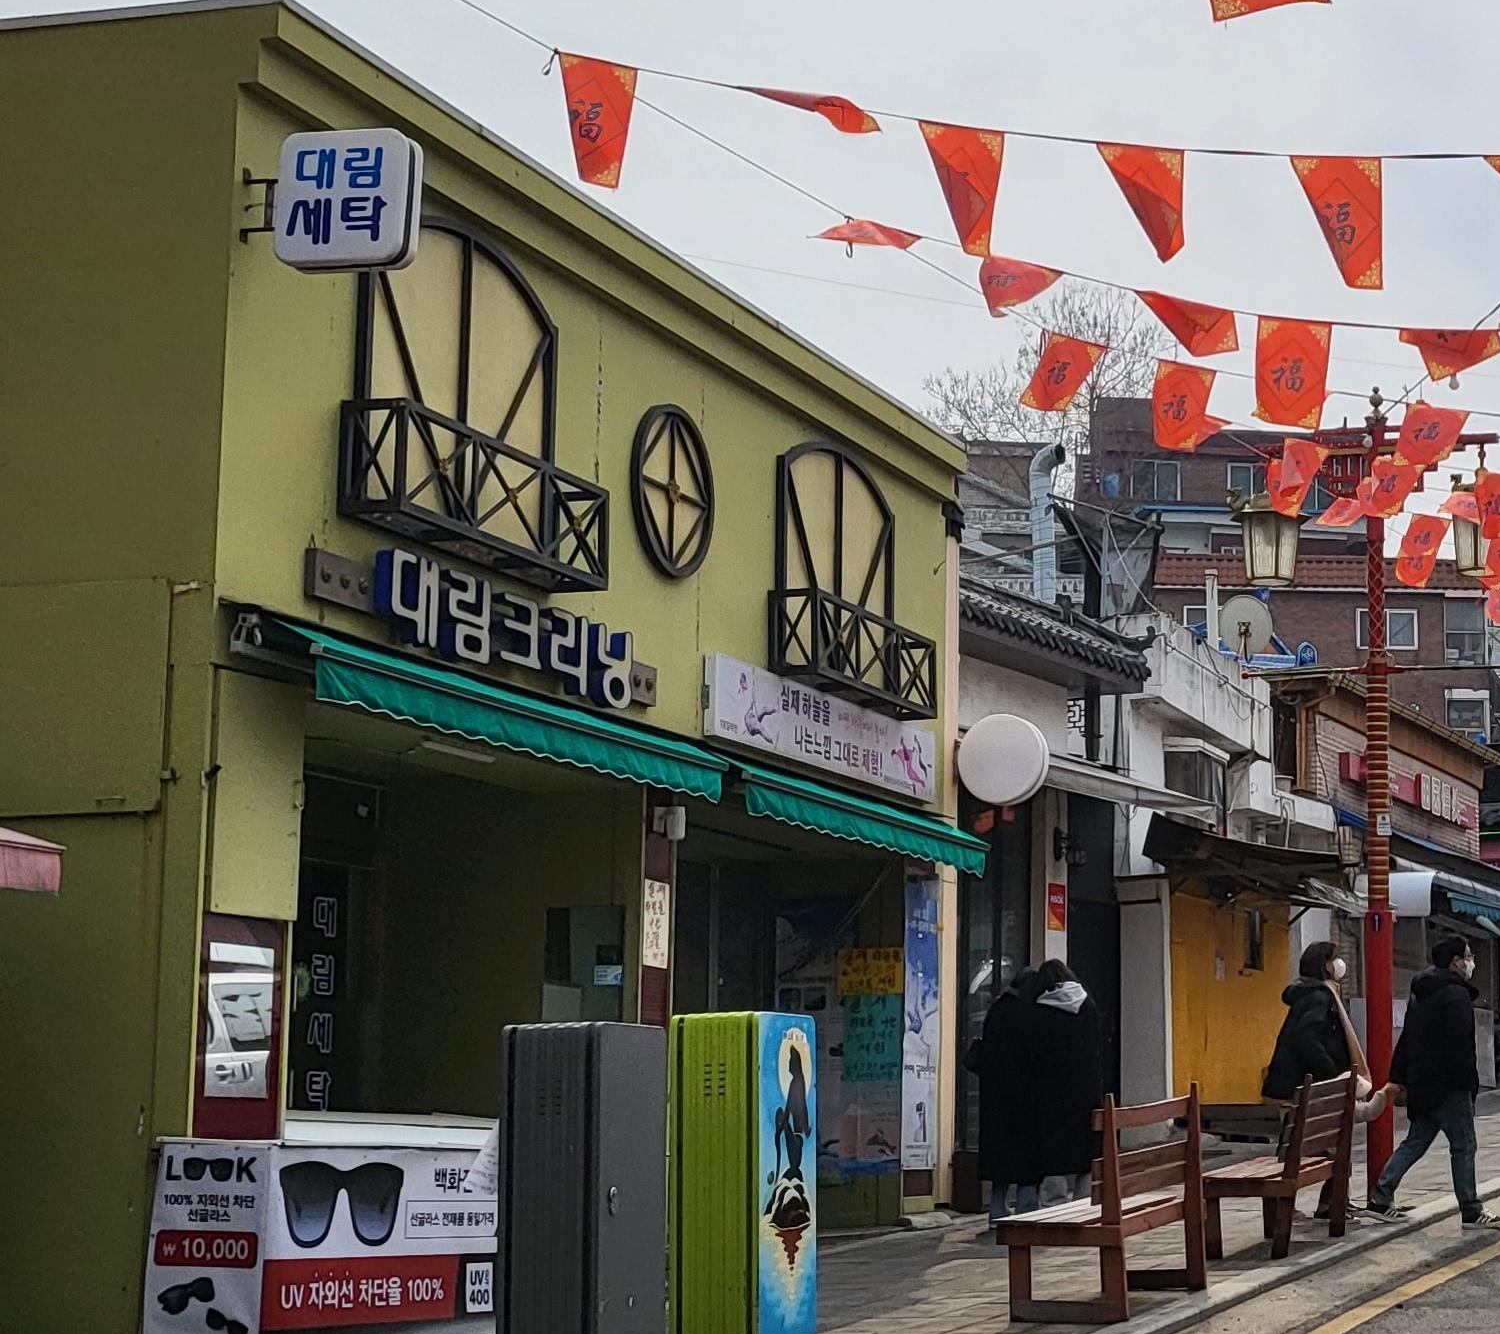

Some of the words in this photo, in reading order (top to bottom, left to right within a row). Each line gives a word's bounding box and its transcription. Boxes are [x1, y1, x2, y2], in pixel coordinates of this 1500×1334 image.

[296, 147, 383, 189] 대림
[286, 196, 387, 245] 세탁
[1271, 359, 1305, 393] 福
[391, 549, 633, 709] 대림크리닝
[781, 684, 800, 715] 실제
[802, 693, 830, 726] 하늘을
[833, 740, 859, 768] 그대로
[166, 1156, 257, 1182] LOOK
[164, 1194, 194, 1206] 100%
[197, 1194, 230, 1208] 자외선
[233, 1195, 256, 1208] 차단
[187, 1209, 231, 1222] 선글라스
[182, 1238, 249, 1260] 10,000
[470, 1270, 484, 1286] UV
[281, 1284, 304, 1309] UV
[308, 1278, 354, 1310] 자외선
[358, 1276, 402, 1307] 차단율
[407, 1277, 444, 1302] 100%
[469, 1289, 490, 1306] 400
